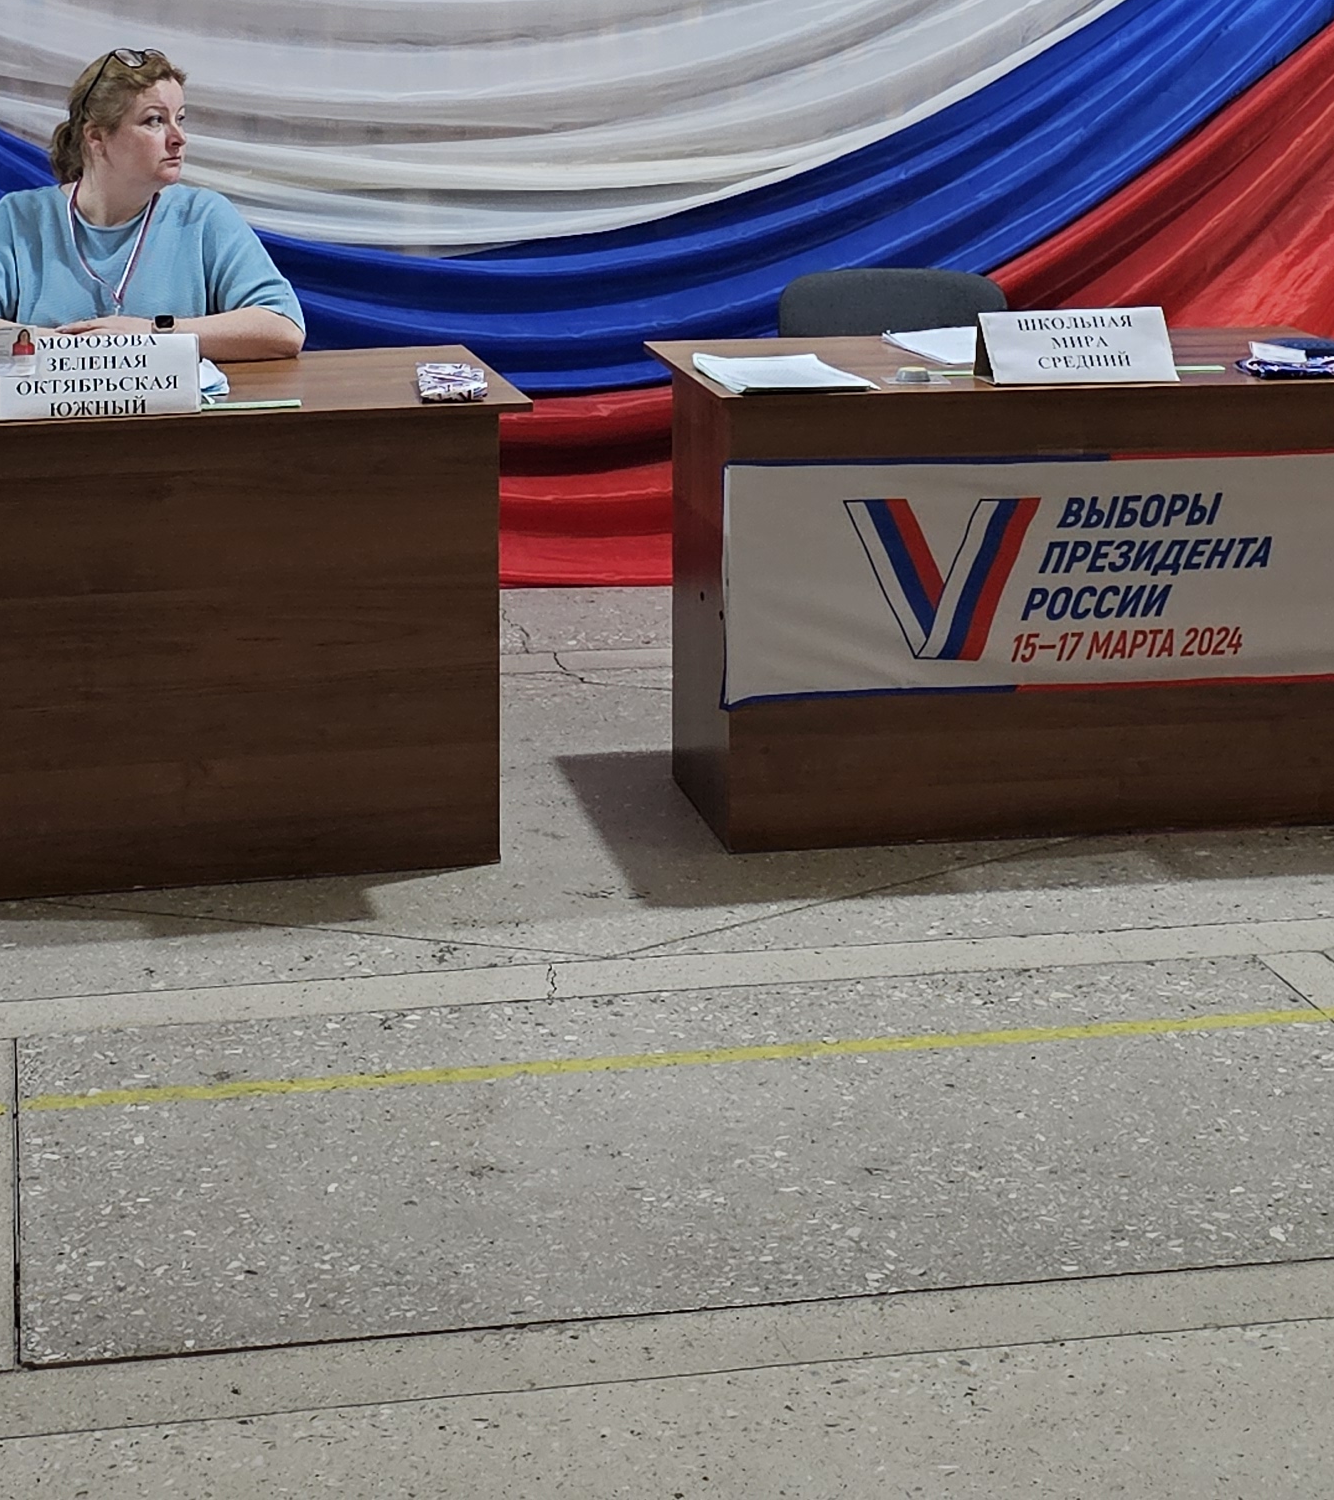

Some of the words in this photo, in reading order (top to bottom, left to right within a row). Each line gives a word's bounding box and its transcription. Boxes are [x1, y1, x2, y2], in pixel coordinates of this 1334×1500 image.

[1017, 315, 1133, 332] ШКОЛЬНАЯ
[37, 334, 157, 351] МОРОЗОВА
[1051, 335, 1109, 350] МИРА
[46, 354, 148, 372] ЗЕЛЕНАЯ
[1038, 350, 1132, 370] СРЕДНИЙ
[16, 375, 179, 396] ОКТЯБРЬСКАЯ
[50, 395, 147, 417] ЮЖНЫЙ
[1057, 492, 1223, 529] ВЫБОРЫ
[1038, 536, 1272, 576] ПРЕЗИДЕНТА
[1021, 584, 1173, 621] РОССИИ
[1086, 628, 1174, 660] МАРТА
[1180, 626, 1243, 657] 2024
